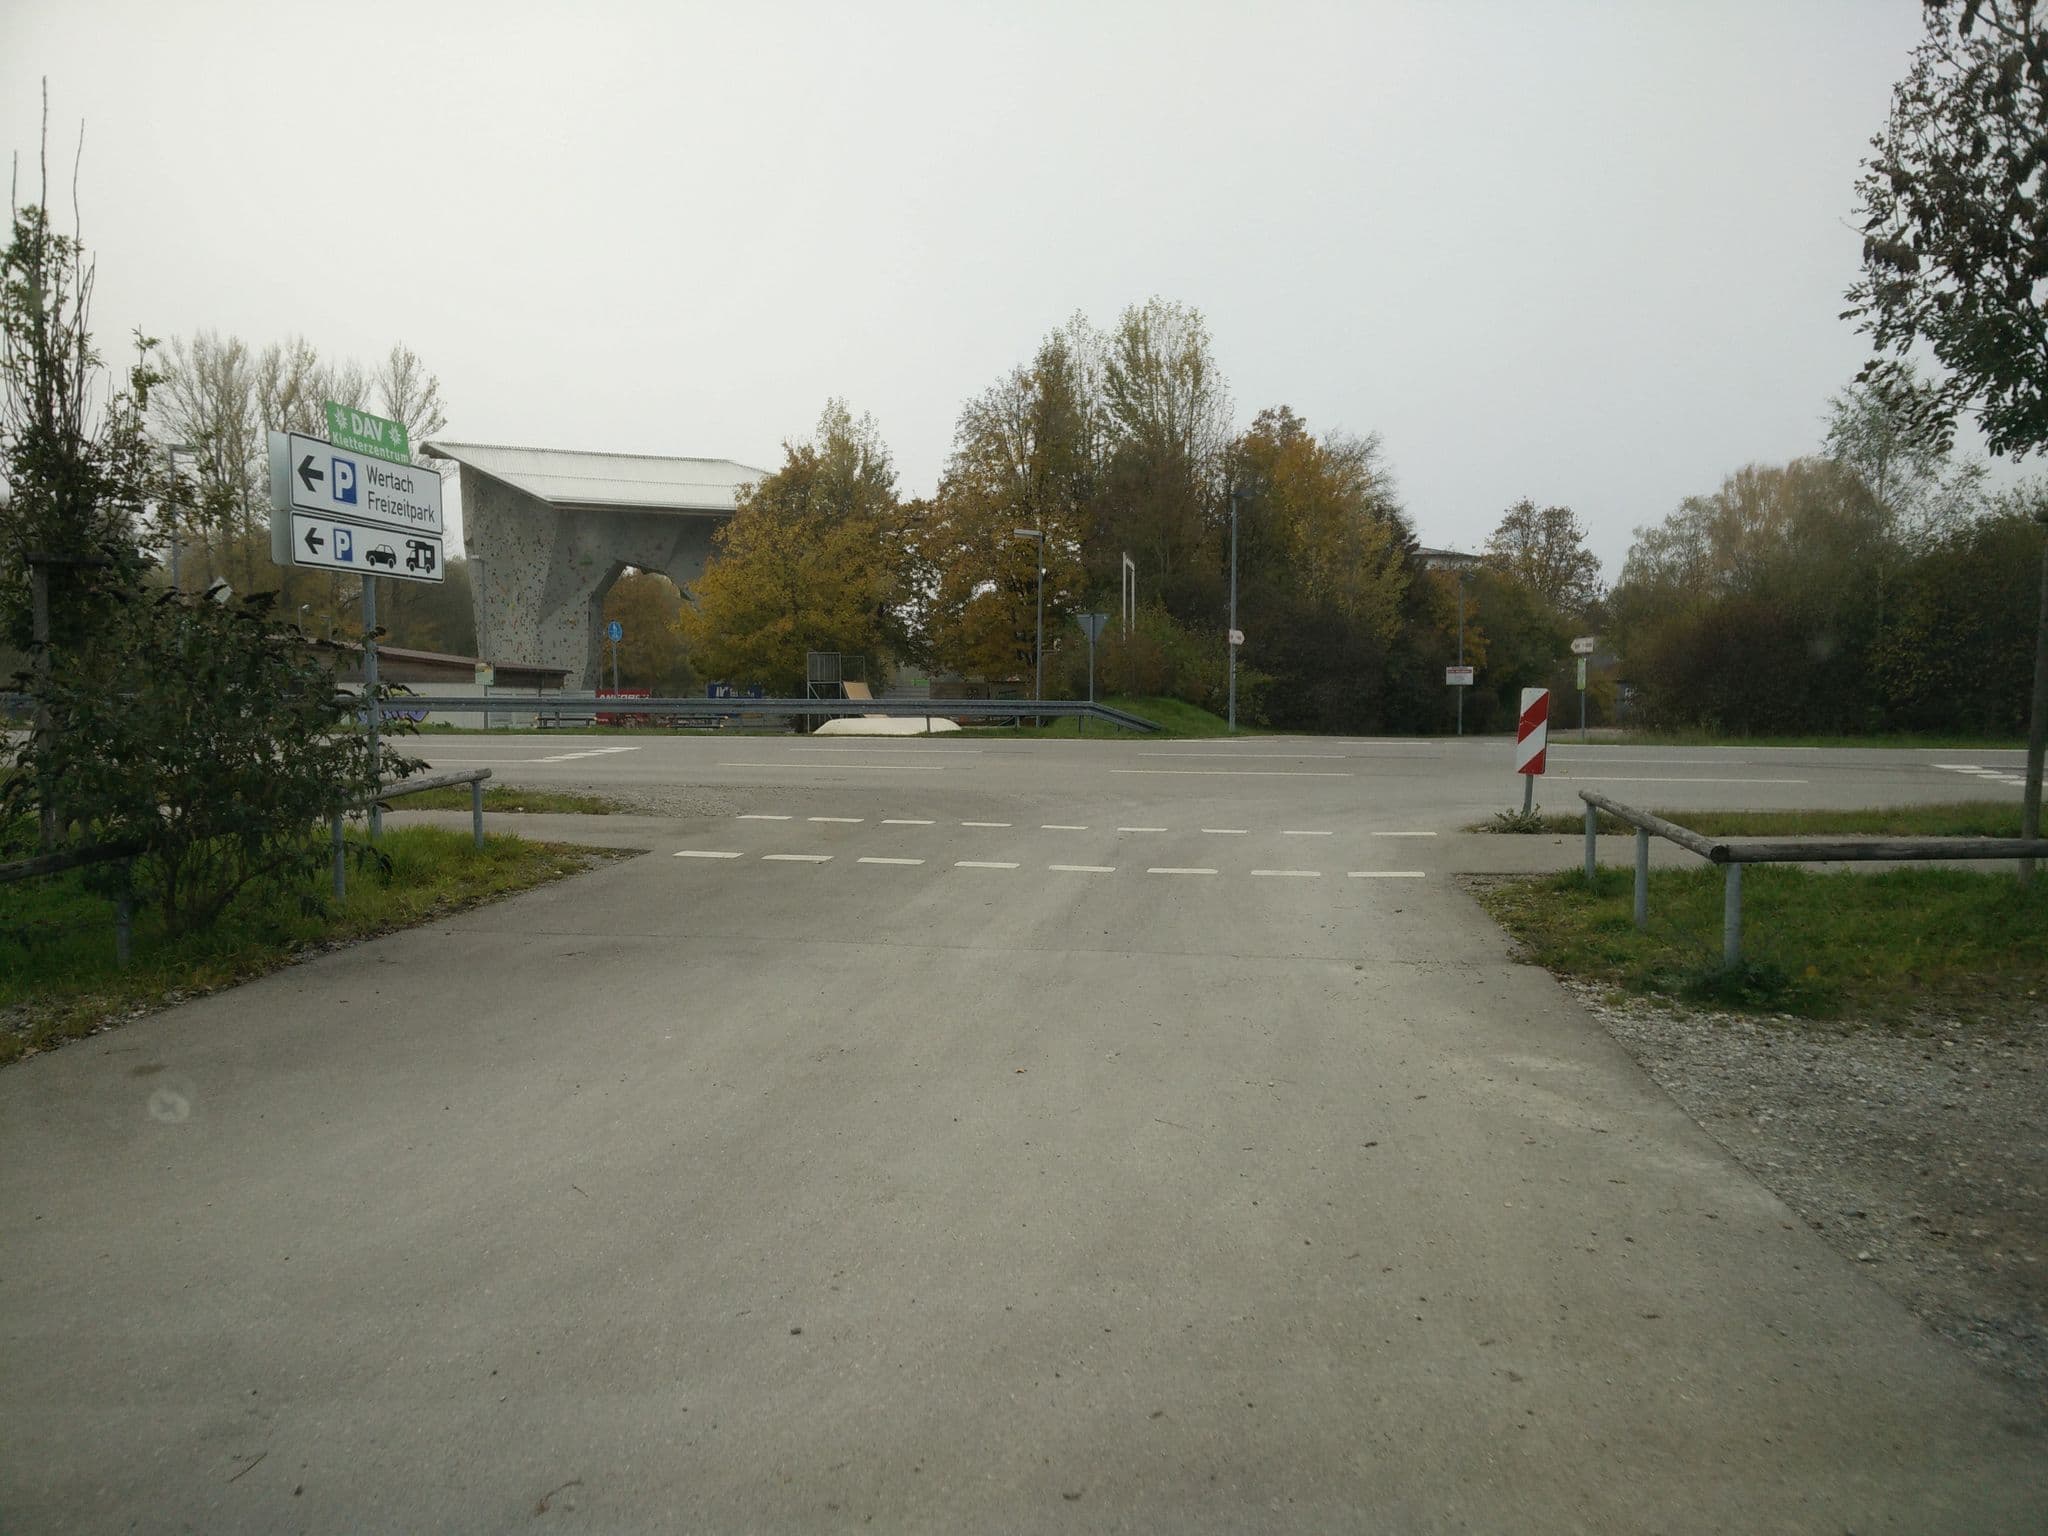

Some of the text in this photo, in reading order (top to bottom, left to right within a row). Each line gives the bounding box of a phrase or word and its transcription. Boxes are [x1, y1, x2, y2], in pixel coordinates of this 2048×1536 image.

[352, 413, 383, 442] DAV
[333, 432, 408, 463] Kletterzentrum
[334, 460, 354, 499] P
[366, 465, 414, 494] Wertach
[367, 491, 435, 523] Freizeitpark
[335, 532, 350, 560] P
